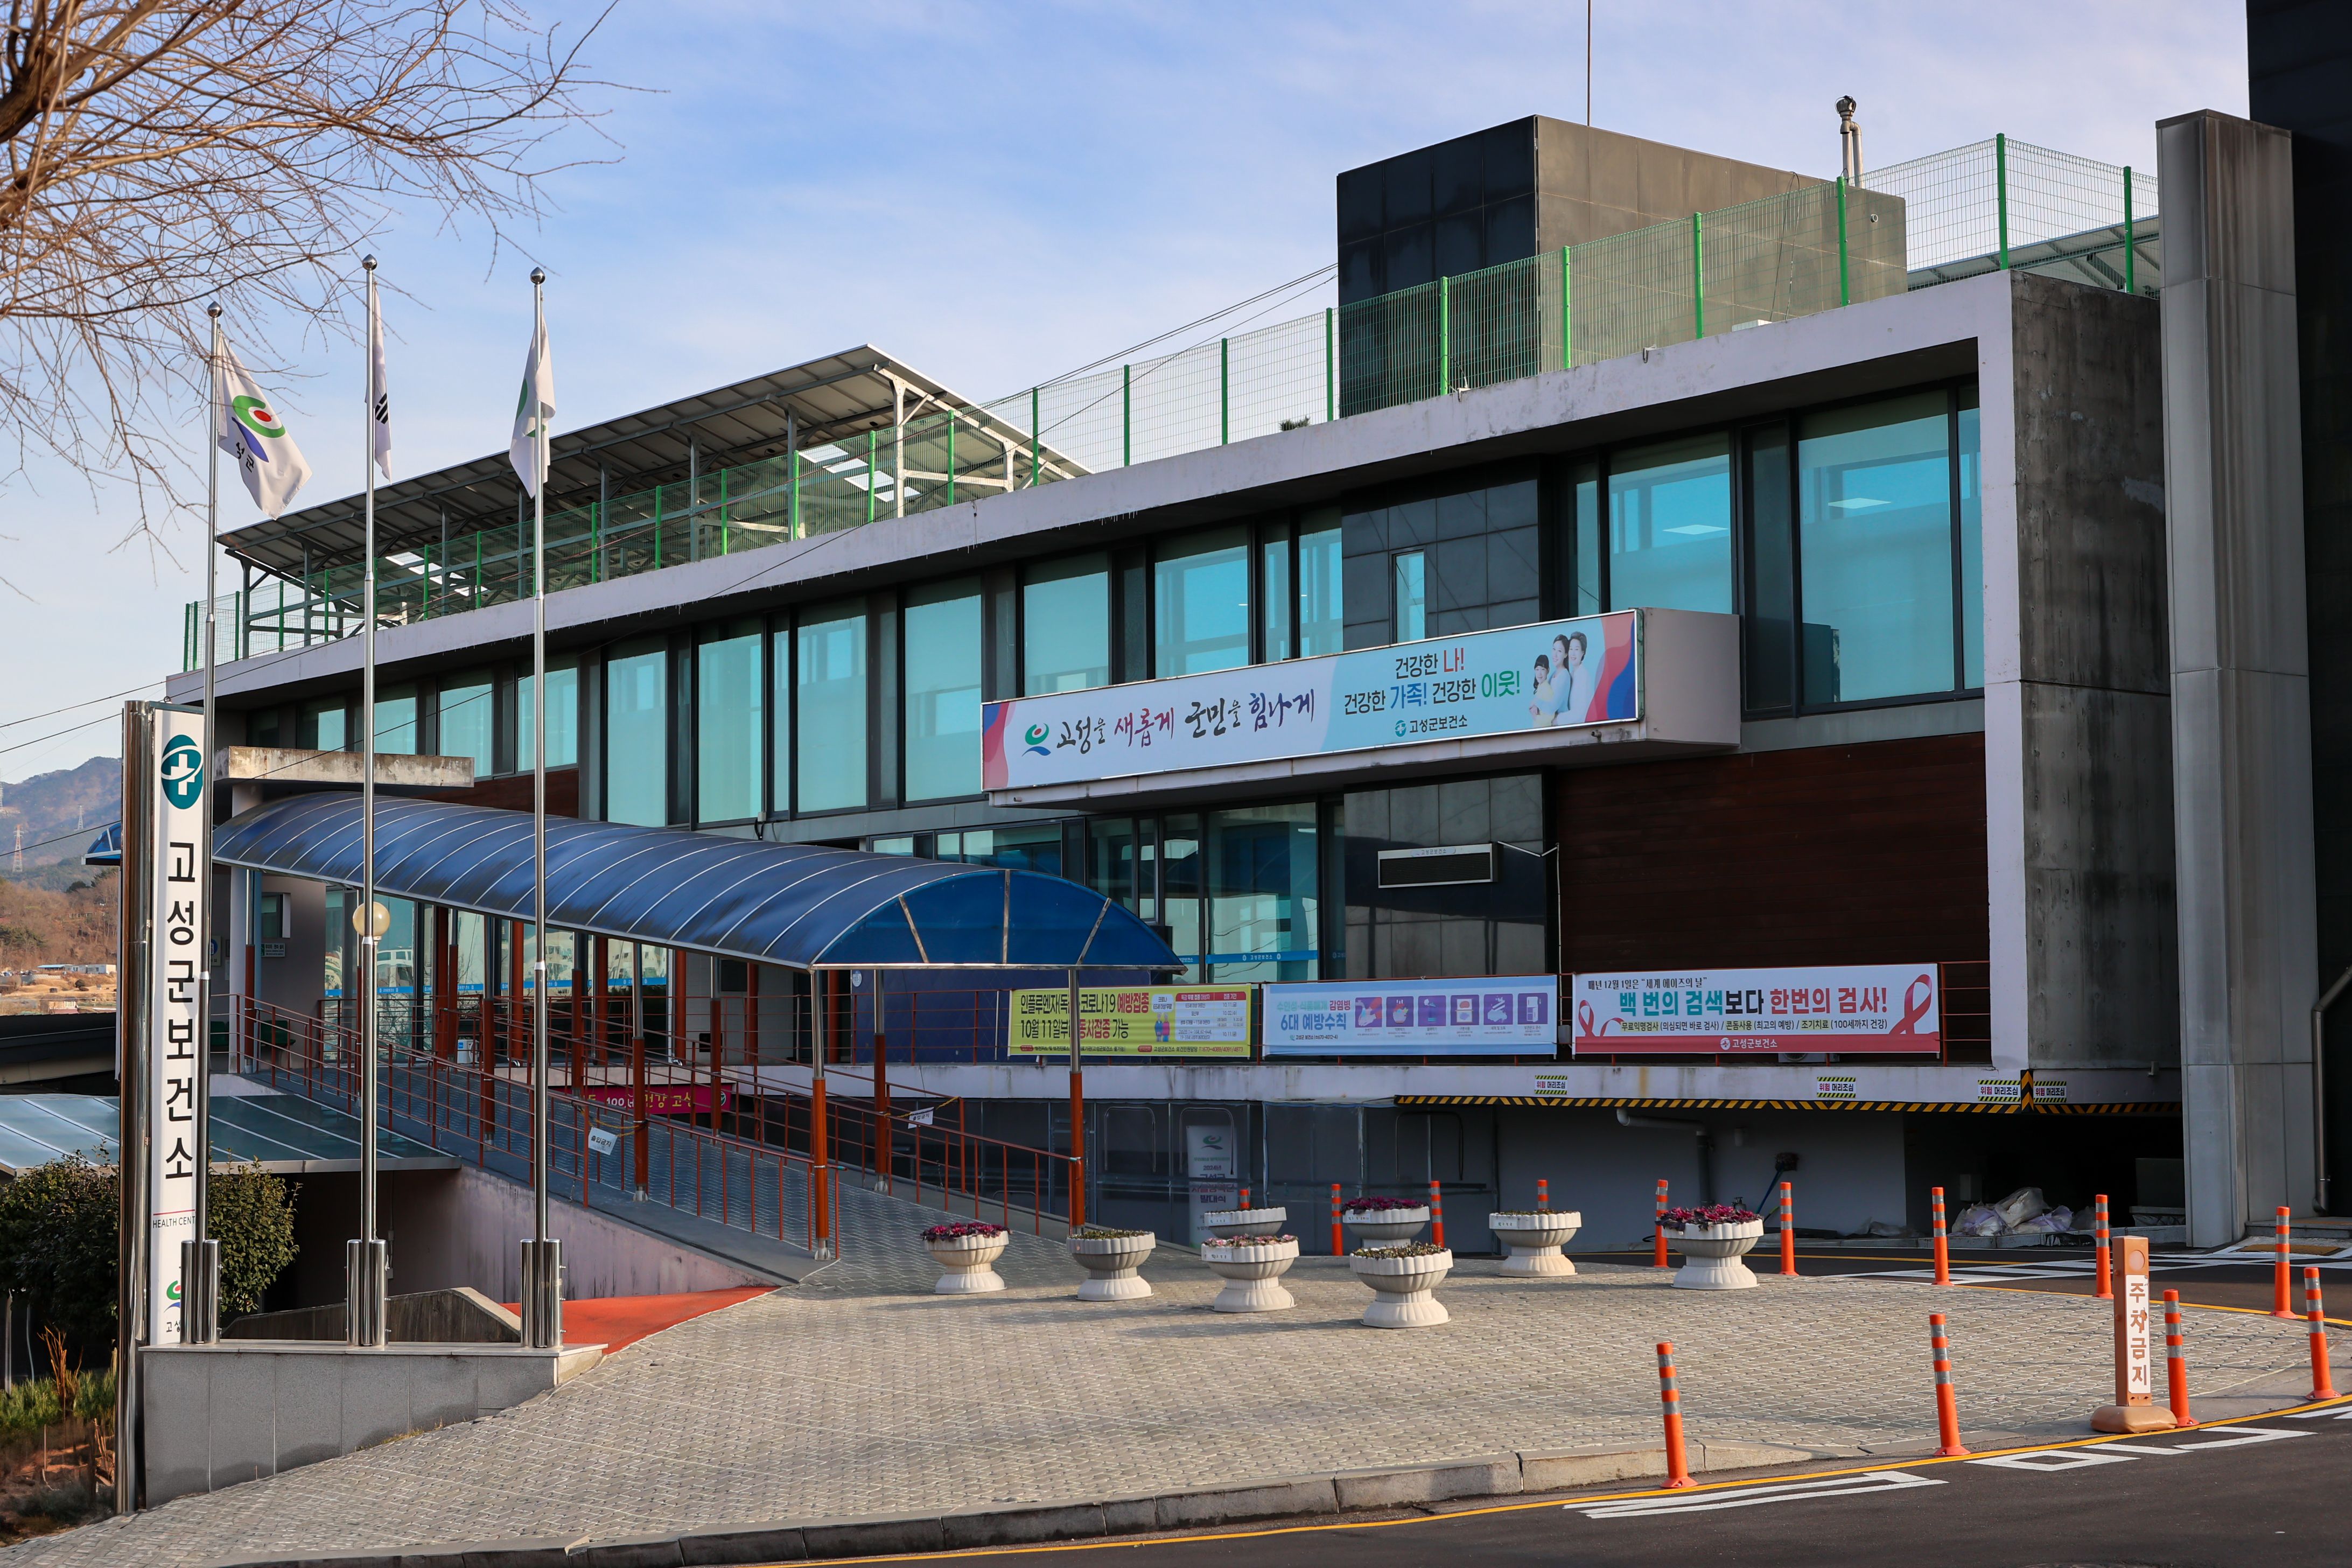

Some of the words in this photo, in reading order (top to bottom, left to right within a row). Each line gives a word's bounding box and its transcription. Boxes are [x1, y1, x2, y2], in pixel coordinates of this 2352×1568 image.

[235, 442, 255, 473] 성군
[1395, 653, 1438, 680] 건강한
[1443, 647, 1465, 673] 나!
[1344, 689, 1385, 715] 건강한
[1389, 682, 1427, 709] 가족!
[1432, 677, 1476, 704] 건강한
[1481, 670, 1521, 698] 이웃!
[1056, 716, 1107, 755] 고성을
[1114, 707, 1175, 748] 새롭게
[1185, 698, 1241, 739] 군민을
[1248, 688, 1315, 733] 힘나게
[1409, 715, 1468, 734] 고성군보건소
[1588, 980, 1602, 991] 매년
[1604, 979, 1619, 990] 12월
[1621, 979, 1639, 990] 1일은
[1663, 977, 1693, 989] 에이즈의
[165, 841, 195, 1179] 고성군보건소
[1117, 992, 1150, 1013] 예방접종
[1329, 1000, 1351, 1011] 감염병
[1620, 992, 1636, 1017] 백
[1643, 991, 1678, 1016] 번의
[1685, 989, 1764, 1016] 검색보다
[1769, 988, 1830, 1014] 한번의
[1838, 987, 1887, 1013] 검사!
[1020, 1019, 1039, 1039] 10월
[1042, 1019, 1071, 1039] 11일부
[1112, 1018, 1129, 1039] 가능
[1280, 1014, 1299, 1031] 6대
[1303, 1013, 1347, 1031] 예방수칙
[1621, 1021, 1659, 1032] 무료익명검사
[1660, 1021, 1688, 1032] (의심되면
[1690, 1021, 1702, 1031] 바로
[1704, 1021, 1719, 1031] 검사)
[1726, 1020, 1752, 1031] 콘돔사용
[1754, 1020, 1776, 1030] (최고의
[1778, 1020, 1794, 1030] 예방)
[1801, 1019, 1828, 1030] 조기치료
[1870, 1019, 1887, 1029] 건강)
[1732, 1039, 1778, 1049] 고성군보건소
[1819, 1083, 1830, 1091] 위험
[1832, 1083, 1854, 1092] 머리조심
[1980, 1087, 1992, 1095] 위험
[1994, 1087, 2018, 1096] 머리조심
[2035, 1088, 2045, 1096] 위험
[2046, 1088, 2065, 1096] 머리조심
[591, 1135, 612, 1147] 출입금지
[1200, 1194, 1226, 1203] 발대식
[153, 1217, 177, 1229] HEALTH
[178, 1215, 195, 1226] CENT
[2129, 1282, 2148, 1387] 주차금지
